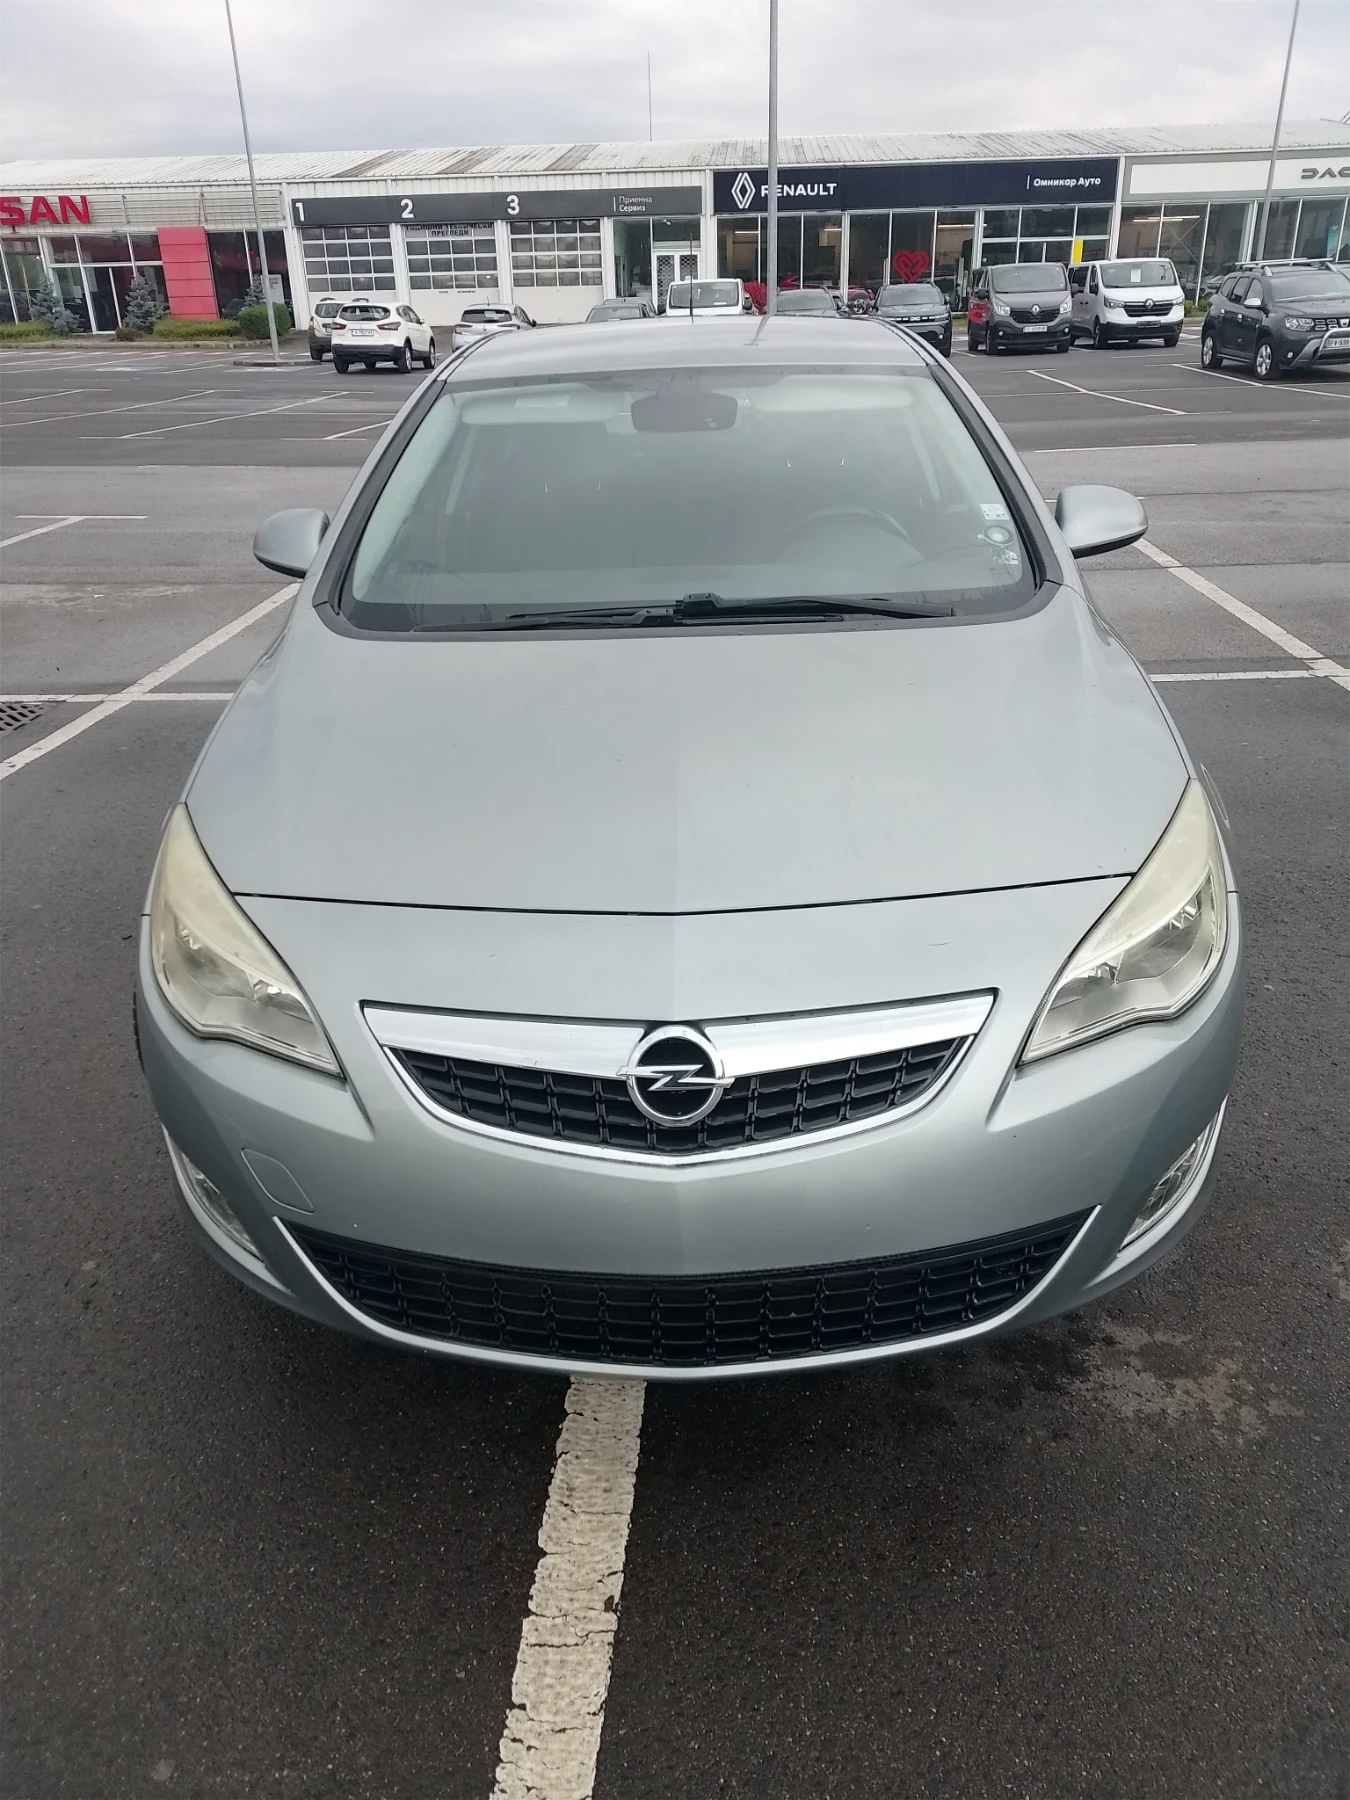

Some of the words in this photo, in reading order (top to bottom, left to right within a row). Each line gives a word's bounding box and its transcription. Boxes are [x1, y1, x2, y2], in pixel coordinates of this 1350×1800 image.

[760, 183, 837, 197] RENAULT
[1033, 178, 1077, 188] Омникар
[1077, 177, 1101, 187] Ауто
[506, 195, 520, 215] 3
[619, 195, 653, 204] Приемна
[295, 202, 305, 221] 1
[400, 199, 414, 218] 2
